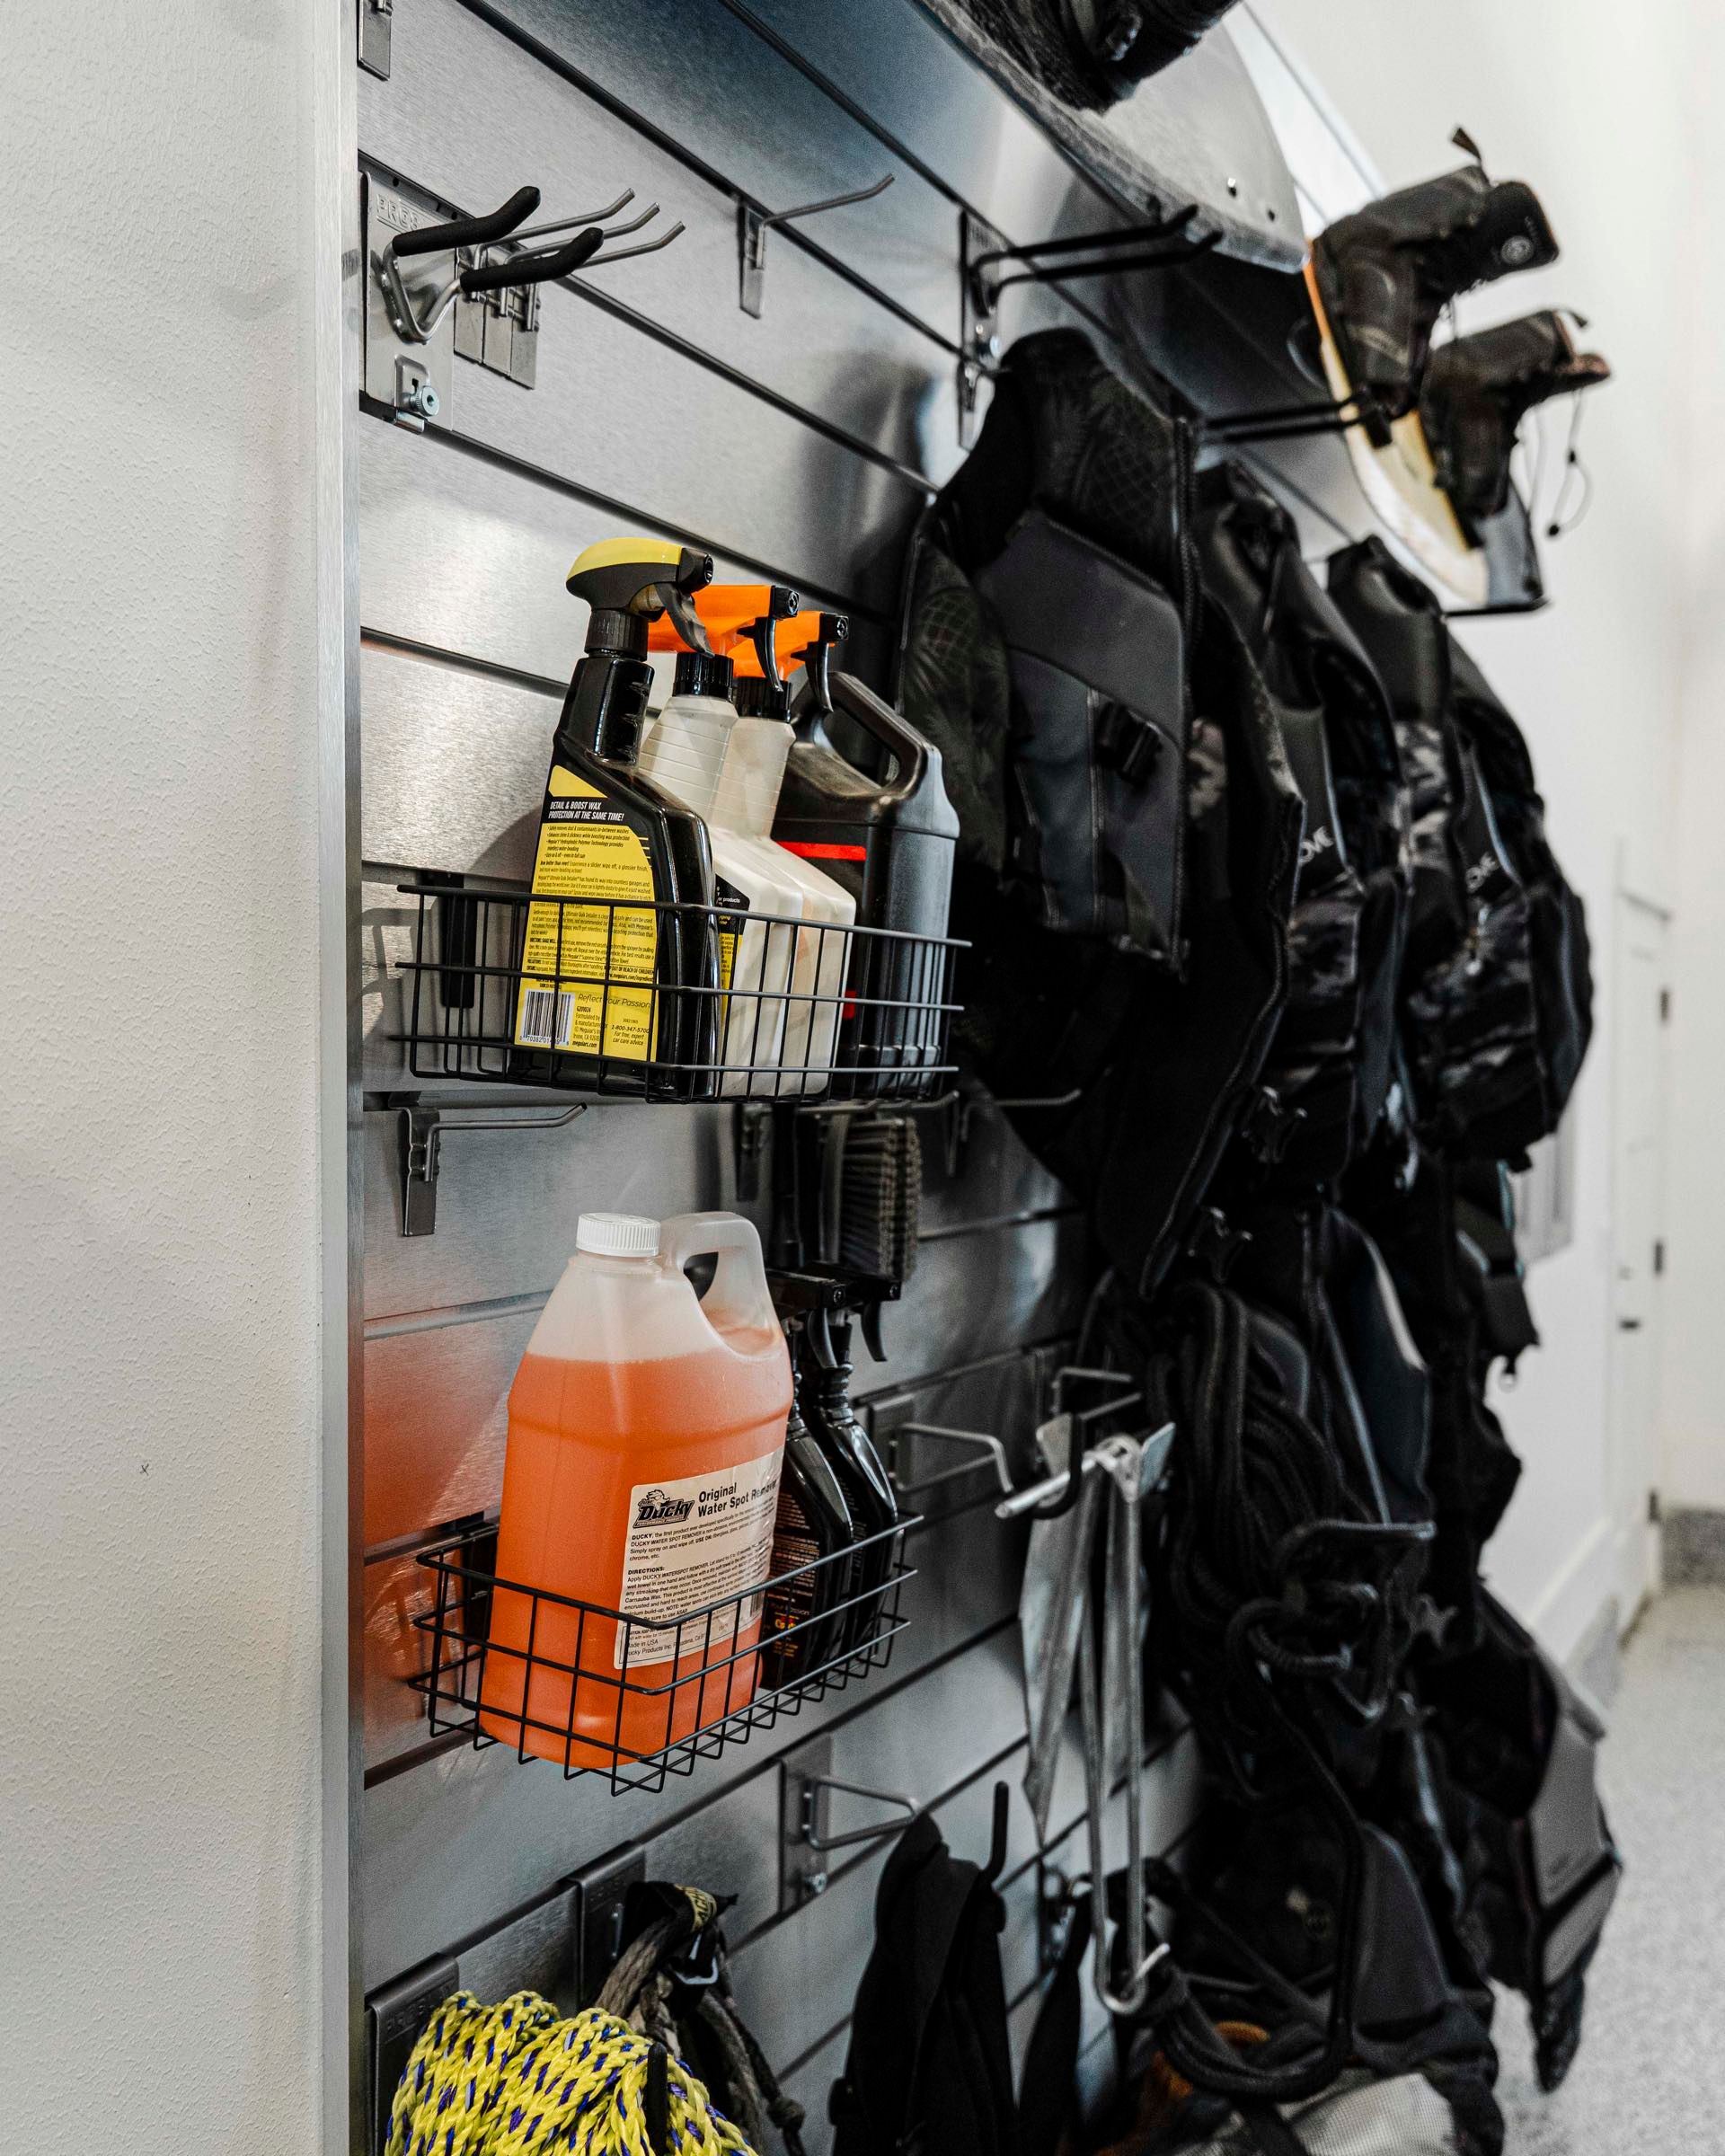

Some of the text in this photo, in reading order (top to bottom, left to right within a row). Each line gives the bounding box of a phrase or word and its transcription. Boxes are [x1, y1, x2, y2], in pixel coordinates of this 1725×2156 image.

[550, 801, 602, 810] DETAIL & BOOST WAX
[548, 810, 624, 821] PROTECTION AT THE SAME TIME!
[579, 993, 603, 1003] Reflect
[622, 999, 650, 1008] Passion
[699, 1482, 737, 1502] Original
[639, 1500, 692, 1520] Ducky
[698, 1502, 728, 1517] Water
[730, 1492, 748, 1509] Spot
[681, 1531, 700, 1539] REMOVER
[630, 1547, 646, 1555] Simply
[628, 1567, 664, 1575] DIRECTIONS:
